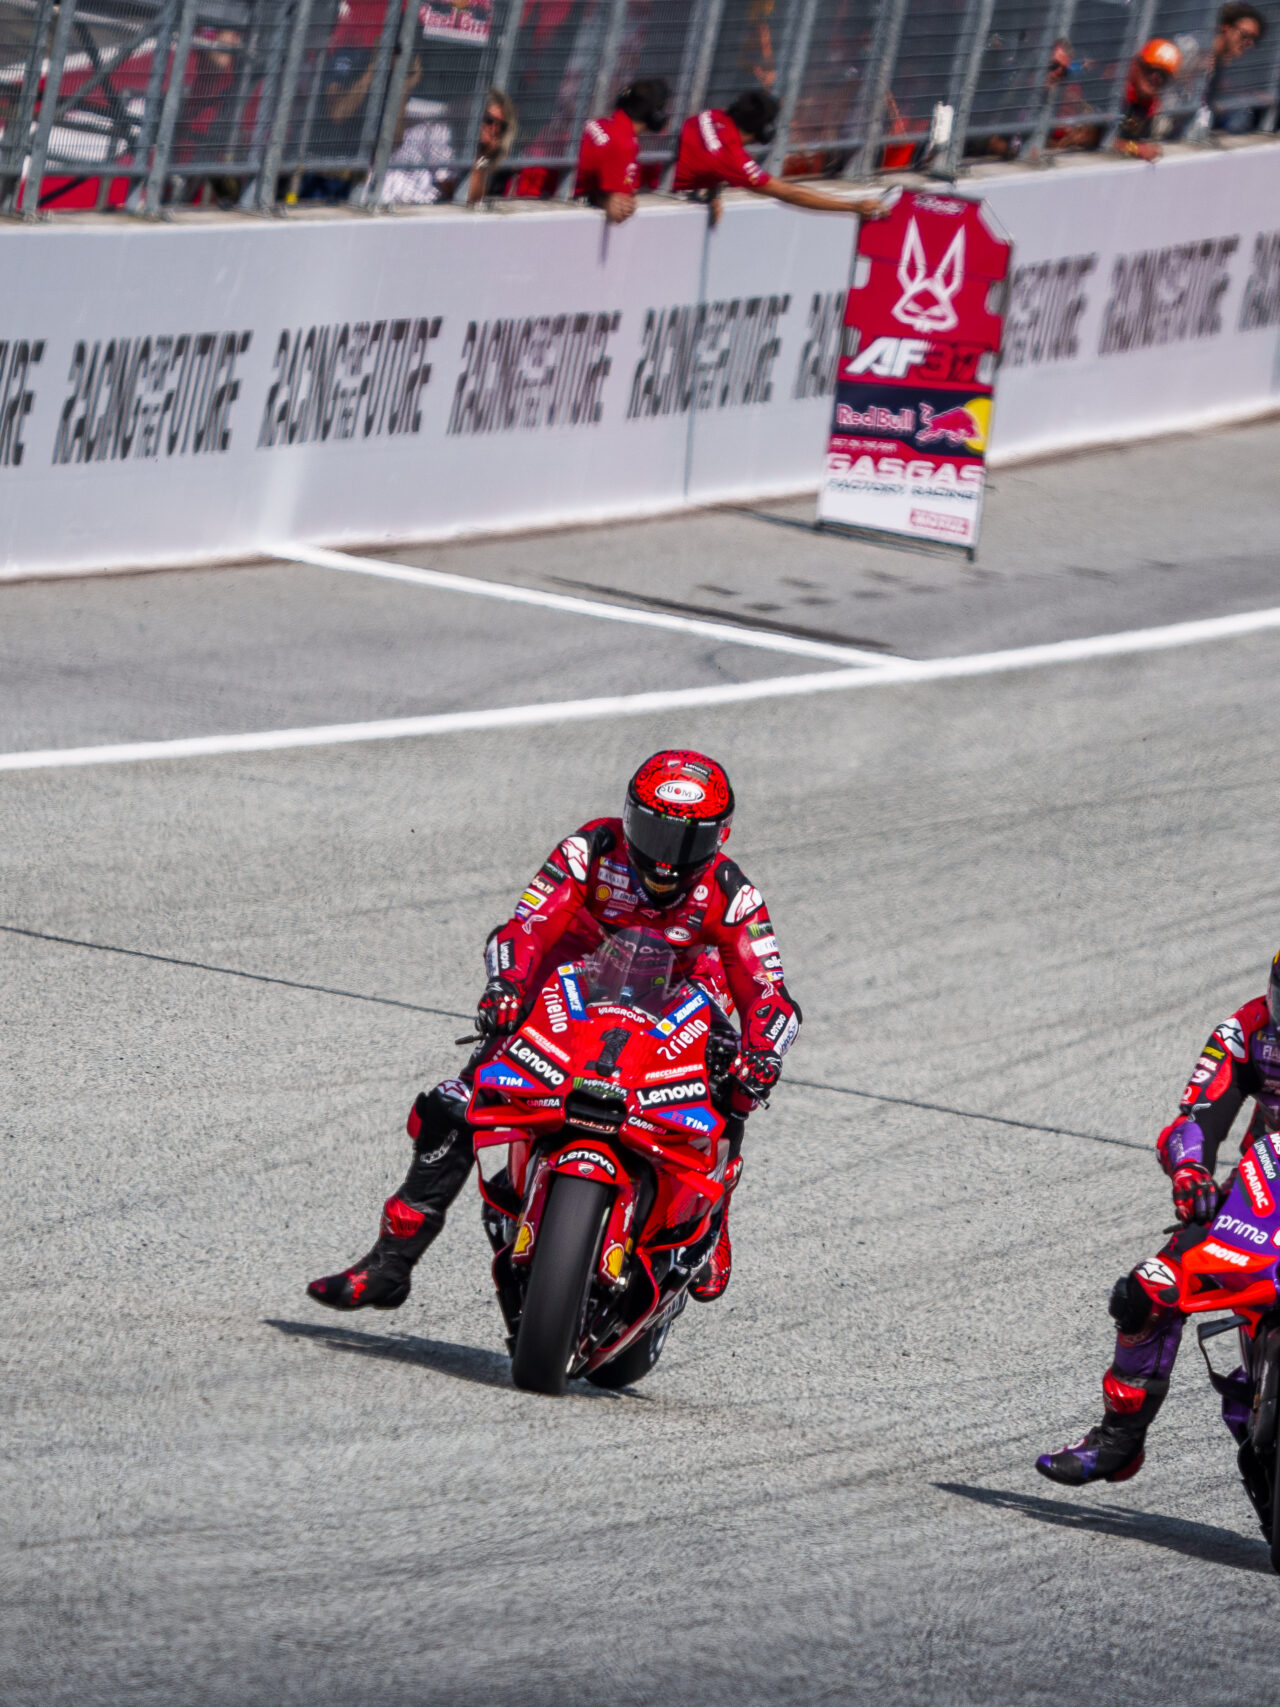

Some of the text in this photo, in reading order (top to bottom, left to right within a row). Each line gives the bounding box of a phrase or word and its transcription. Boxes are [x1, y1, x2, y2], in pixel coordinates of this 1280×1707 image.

[836, 402, 916, 430] Red Bull
[825, 452, 986, 489] GASGAS
[597, 1006, 646, 1024] VARGROUP
[669, 1018, 709, 1055] riello
[509, 1038, 565, 1086] Lenovo
[645, 1063, 704, 1081] FRECCIAROSSA
[498, 1075, 524, 1088] TIM
[583, 1078, 628, 1097] MONSTER
[636, 1082, 707, 1106] Lenovo
[627, 1115, 668, 1136] CARRERA
[684, 1116, 709, 1133] TIM
[558, 1149, 617, 1176] Lenovo
[1241, 1160, 1269, 1209] PRAMAC
[1215, 1214, 1268, 1245] prima
[1203, 1242, 1250, 1267] MOTUL
